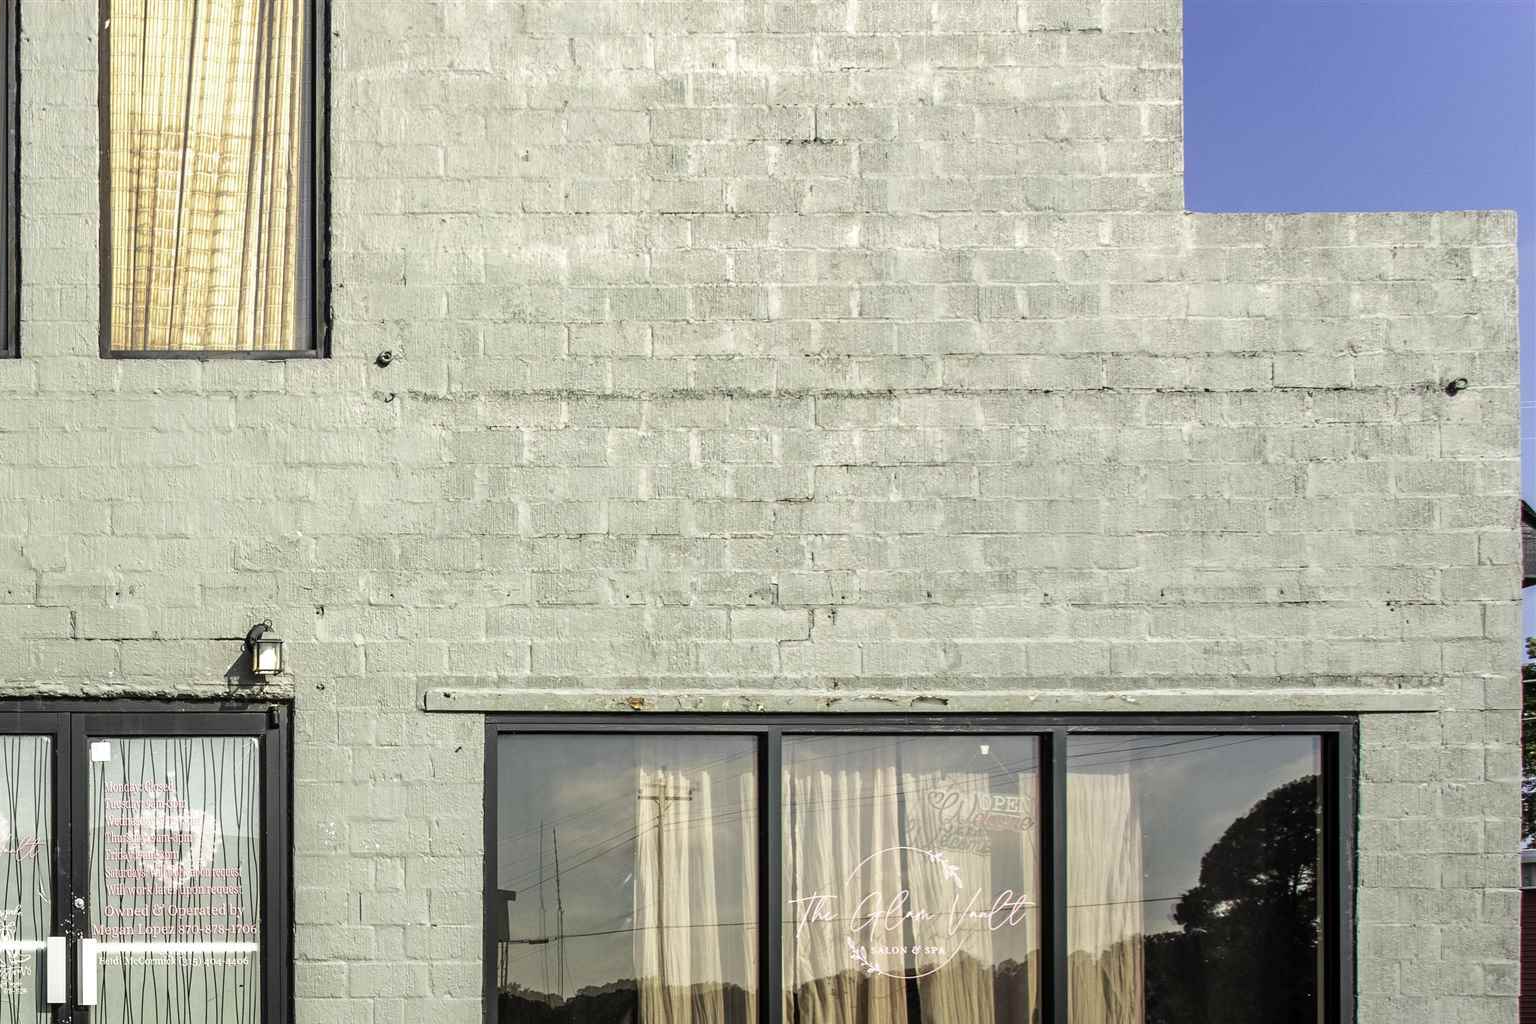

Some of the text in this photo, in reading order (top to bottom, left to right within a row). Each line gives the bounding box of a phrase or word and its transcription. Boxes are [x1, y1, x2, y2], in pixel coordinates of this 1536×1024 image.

[144, 782, 177, 793] Closed
[107, 884, 124, 896] Will
[104, 904, 244, 919] Owned & Operated by
[788, 892, 838, 938] The
[949, 888, 1036, 936] Vault
[93, 924, 257, 938] Megan Lopez 870-878-1706
[871, 946, 945, 955] SALON & SPA
